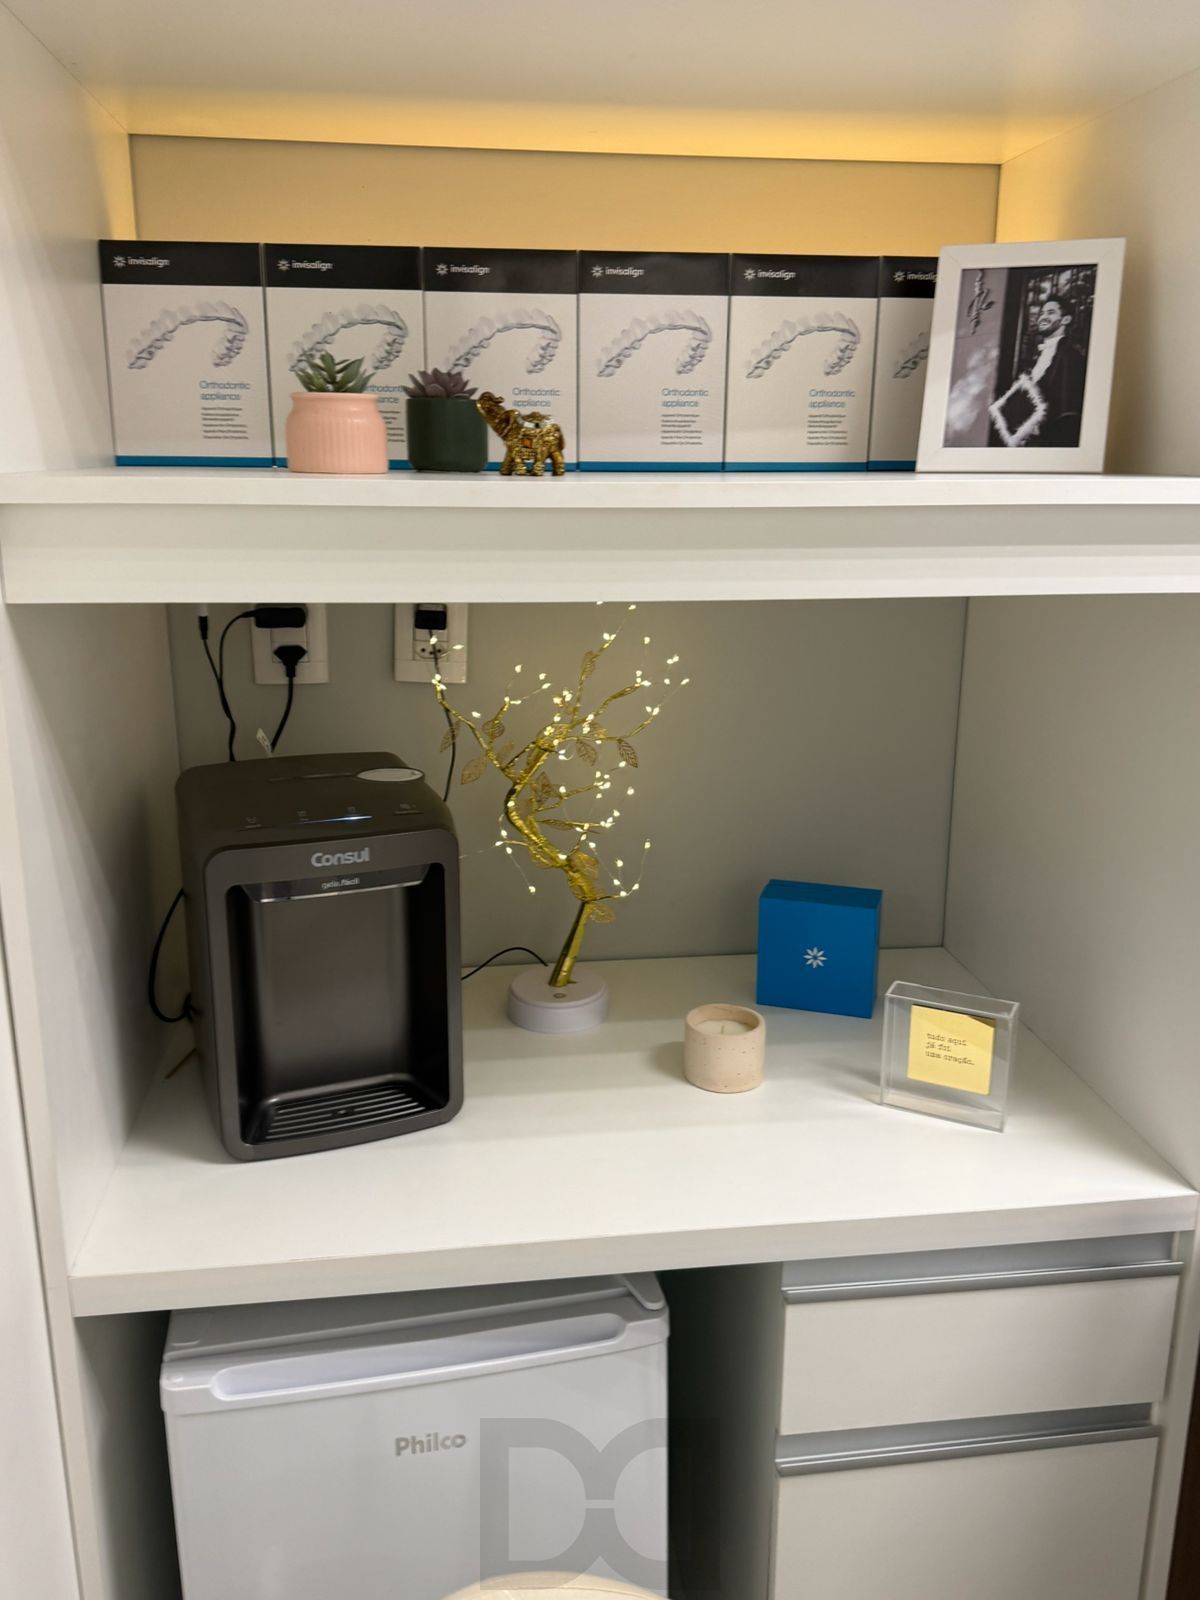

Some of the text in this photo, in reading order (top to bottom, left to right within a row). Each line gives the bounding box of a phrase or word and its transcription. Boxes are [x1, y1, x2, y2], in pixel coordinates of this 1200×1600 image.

[127, 256, 170, 268] invisalign
[291, 259, 333, 271] invisalign
[449, 263, 491, 276] invisalign
[604, 266, 645, 278] invisalign
[757, 268, 796, 281] invisalign
[906, 271, 937, 283] invisalig
[199, 380, 251, 390] Orthodontic
[512, 387, 560, 397] Orthodontic
[661, 387, 709, 397] Orthodontic
[808, 388, 856, 398] Orthodontic
[311, 847, 370, 867] Consul
[927, 1033, 945, 1042] tudo
[925, 1051, 941, 1059] uma
[394, 1431, 467, 1457] Philco
